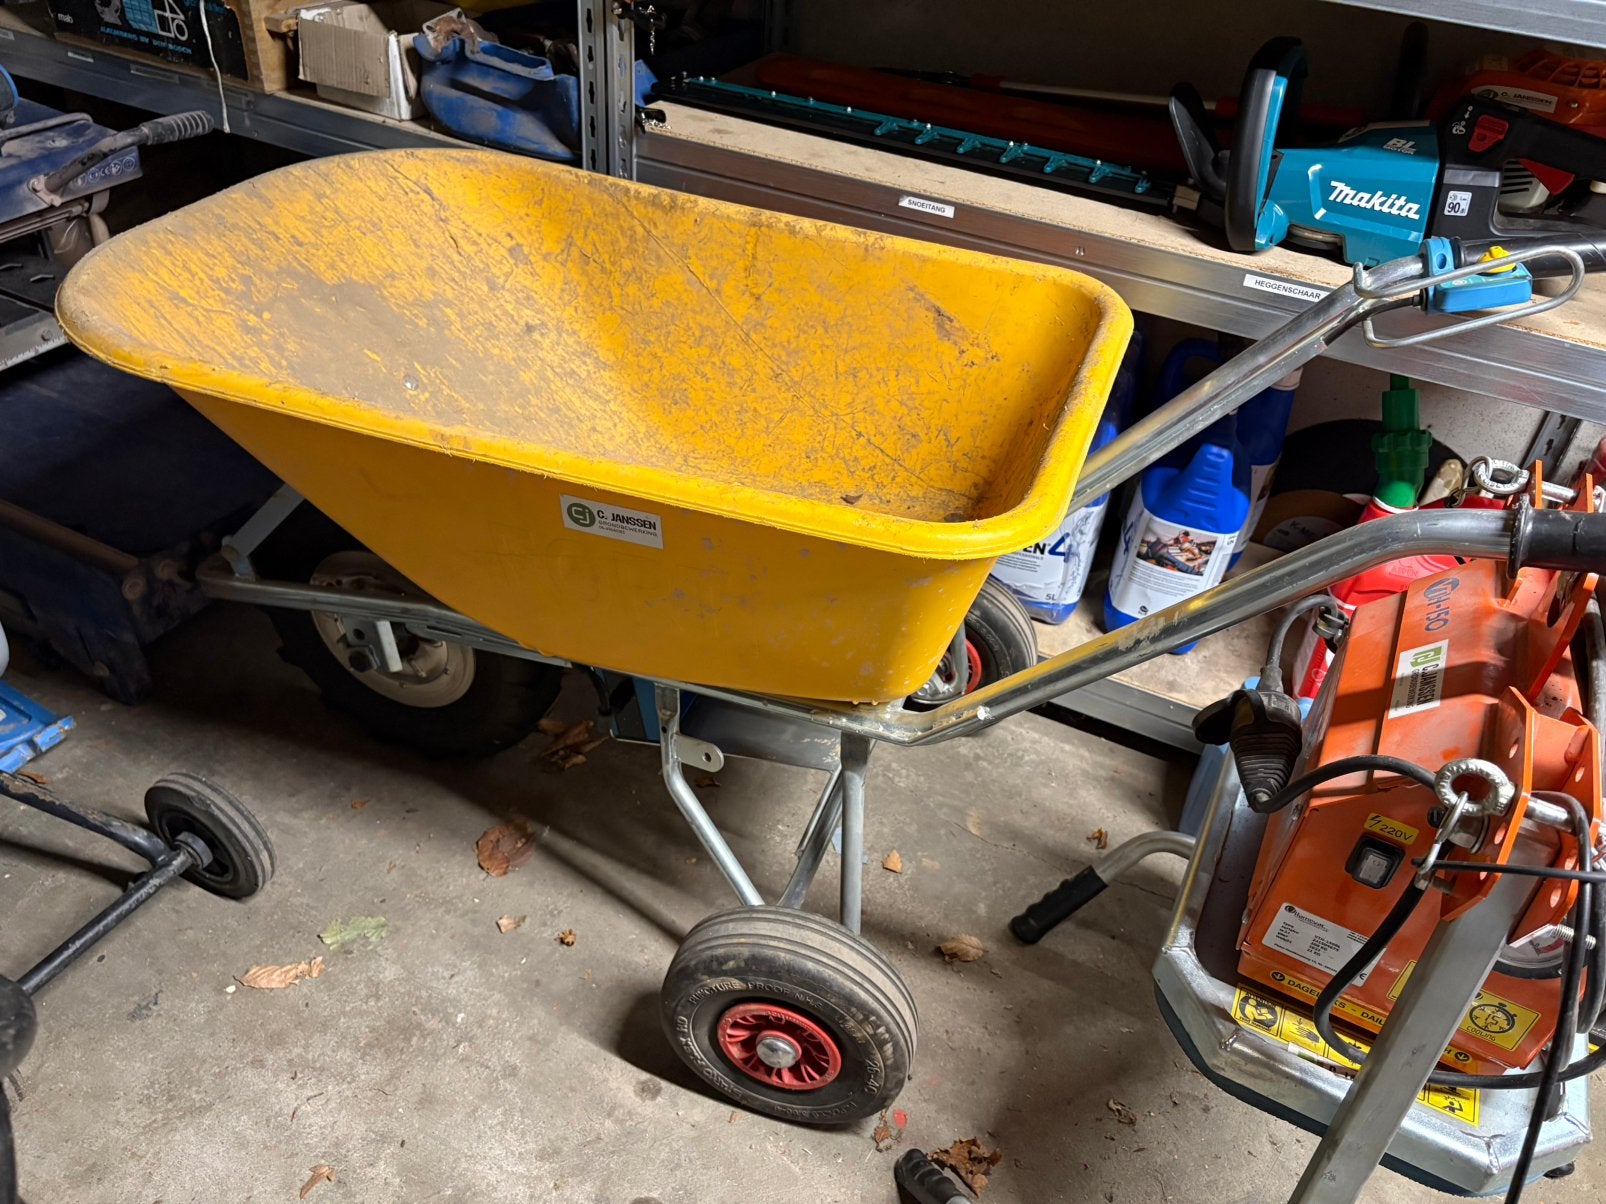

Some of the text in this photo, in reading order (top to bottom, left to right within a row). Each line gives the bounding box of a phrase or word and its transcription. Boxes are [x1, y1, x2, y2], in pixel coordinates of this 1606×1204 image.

[1386, 138, 1416, 150] BL
[907, 199, 946, 213] SNOEITANG
[1448, 202, 1460, 214] 90
[1254, 279, 1321, 300] HEGGENSCHAAR
[611, 512, 657, 531] JANSSEN
[1045, 593, 1057, 602] 5L
[1416, 672, 1437, 706] JANSSEN
[1379, 824, 1414, 841] 220V
[688, 981, 790, 1005] PUNCTURE PROOF
